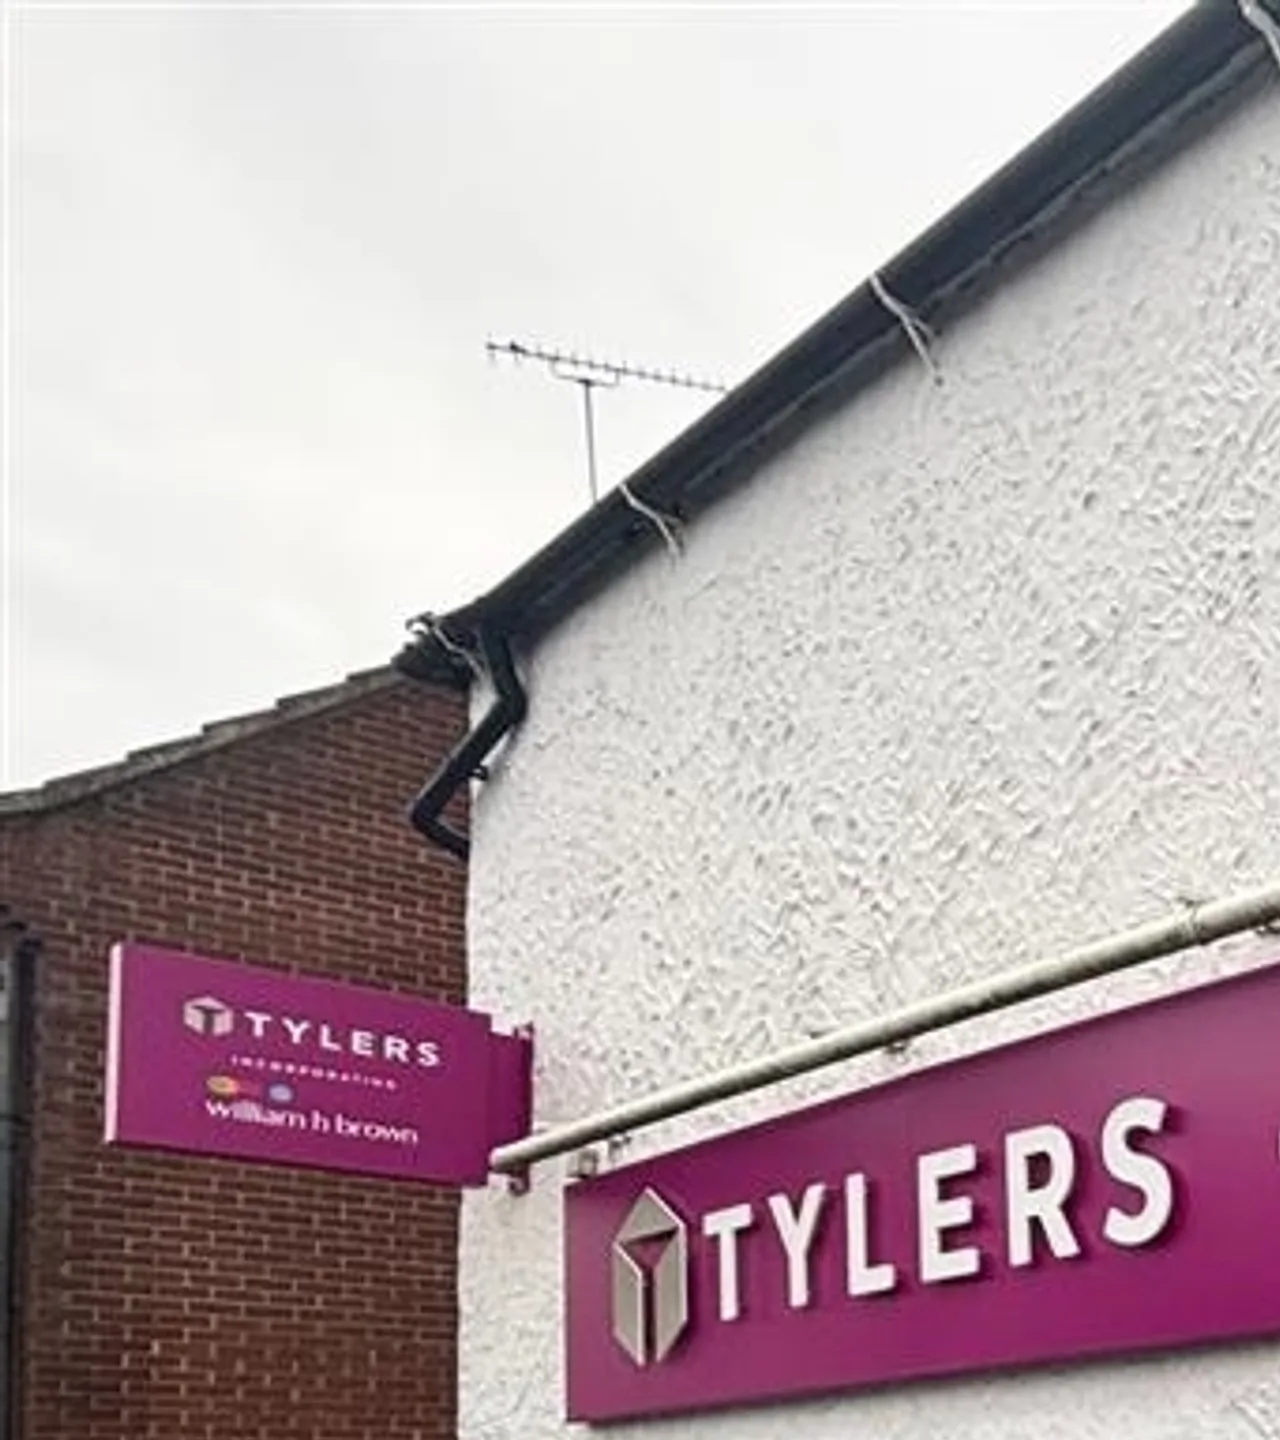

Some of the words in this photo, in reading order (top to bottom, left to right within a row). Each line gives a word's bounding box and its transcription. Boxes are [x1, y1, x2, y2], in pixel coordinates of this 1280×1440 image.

[245, 1012, 440, 1067] TYLERS
[205, 1099, 306, 1130] william
[311, 1110, 330, 1133] h
[335, 1113, 418, 1144] brown
[702, 1097, 1177, 1321] TYLERS
